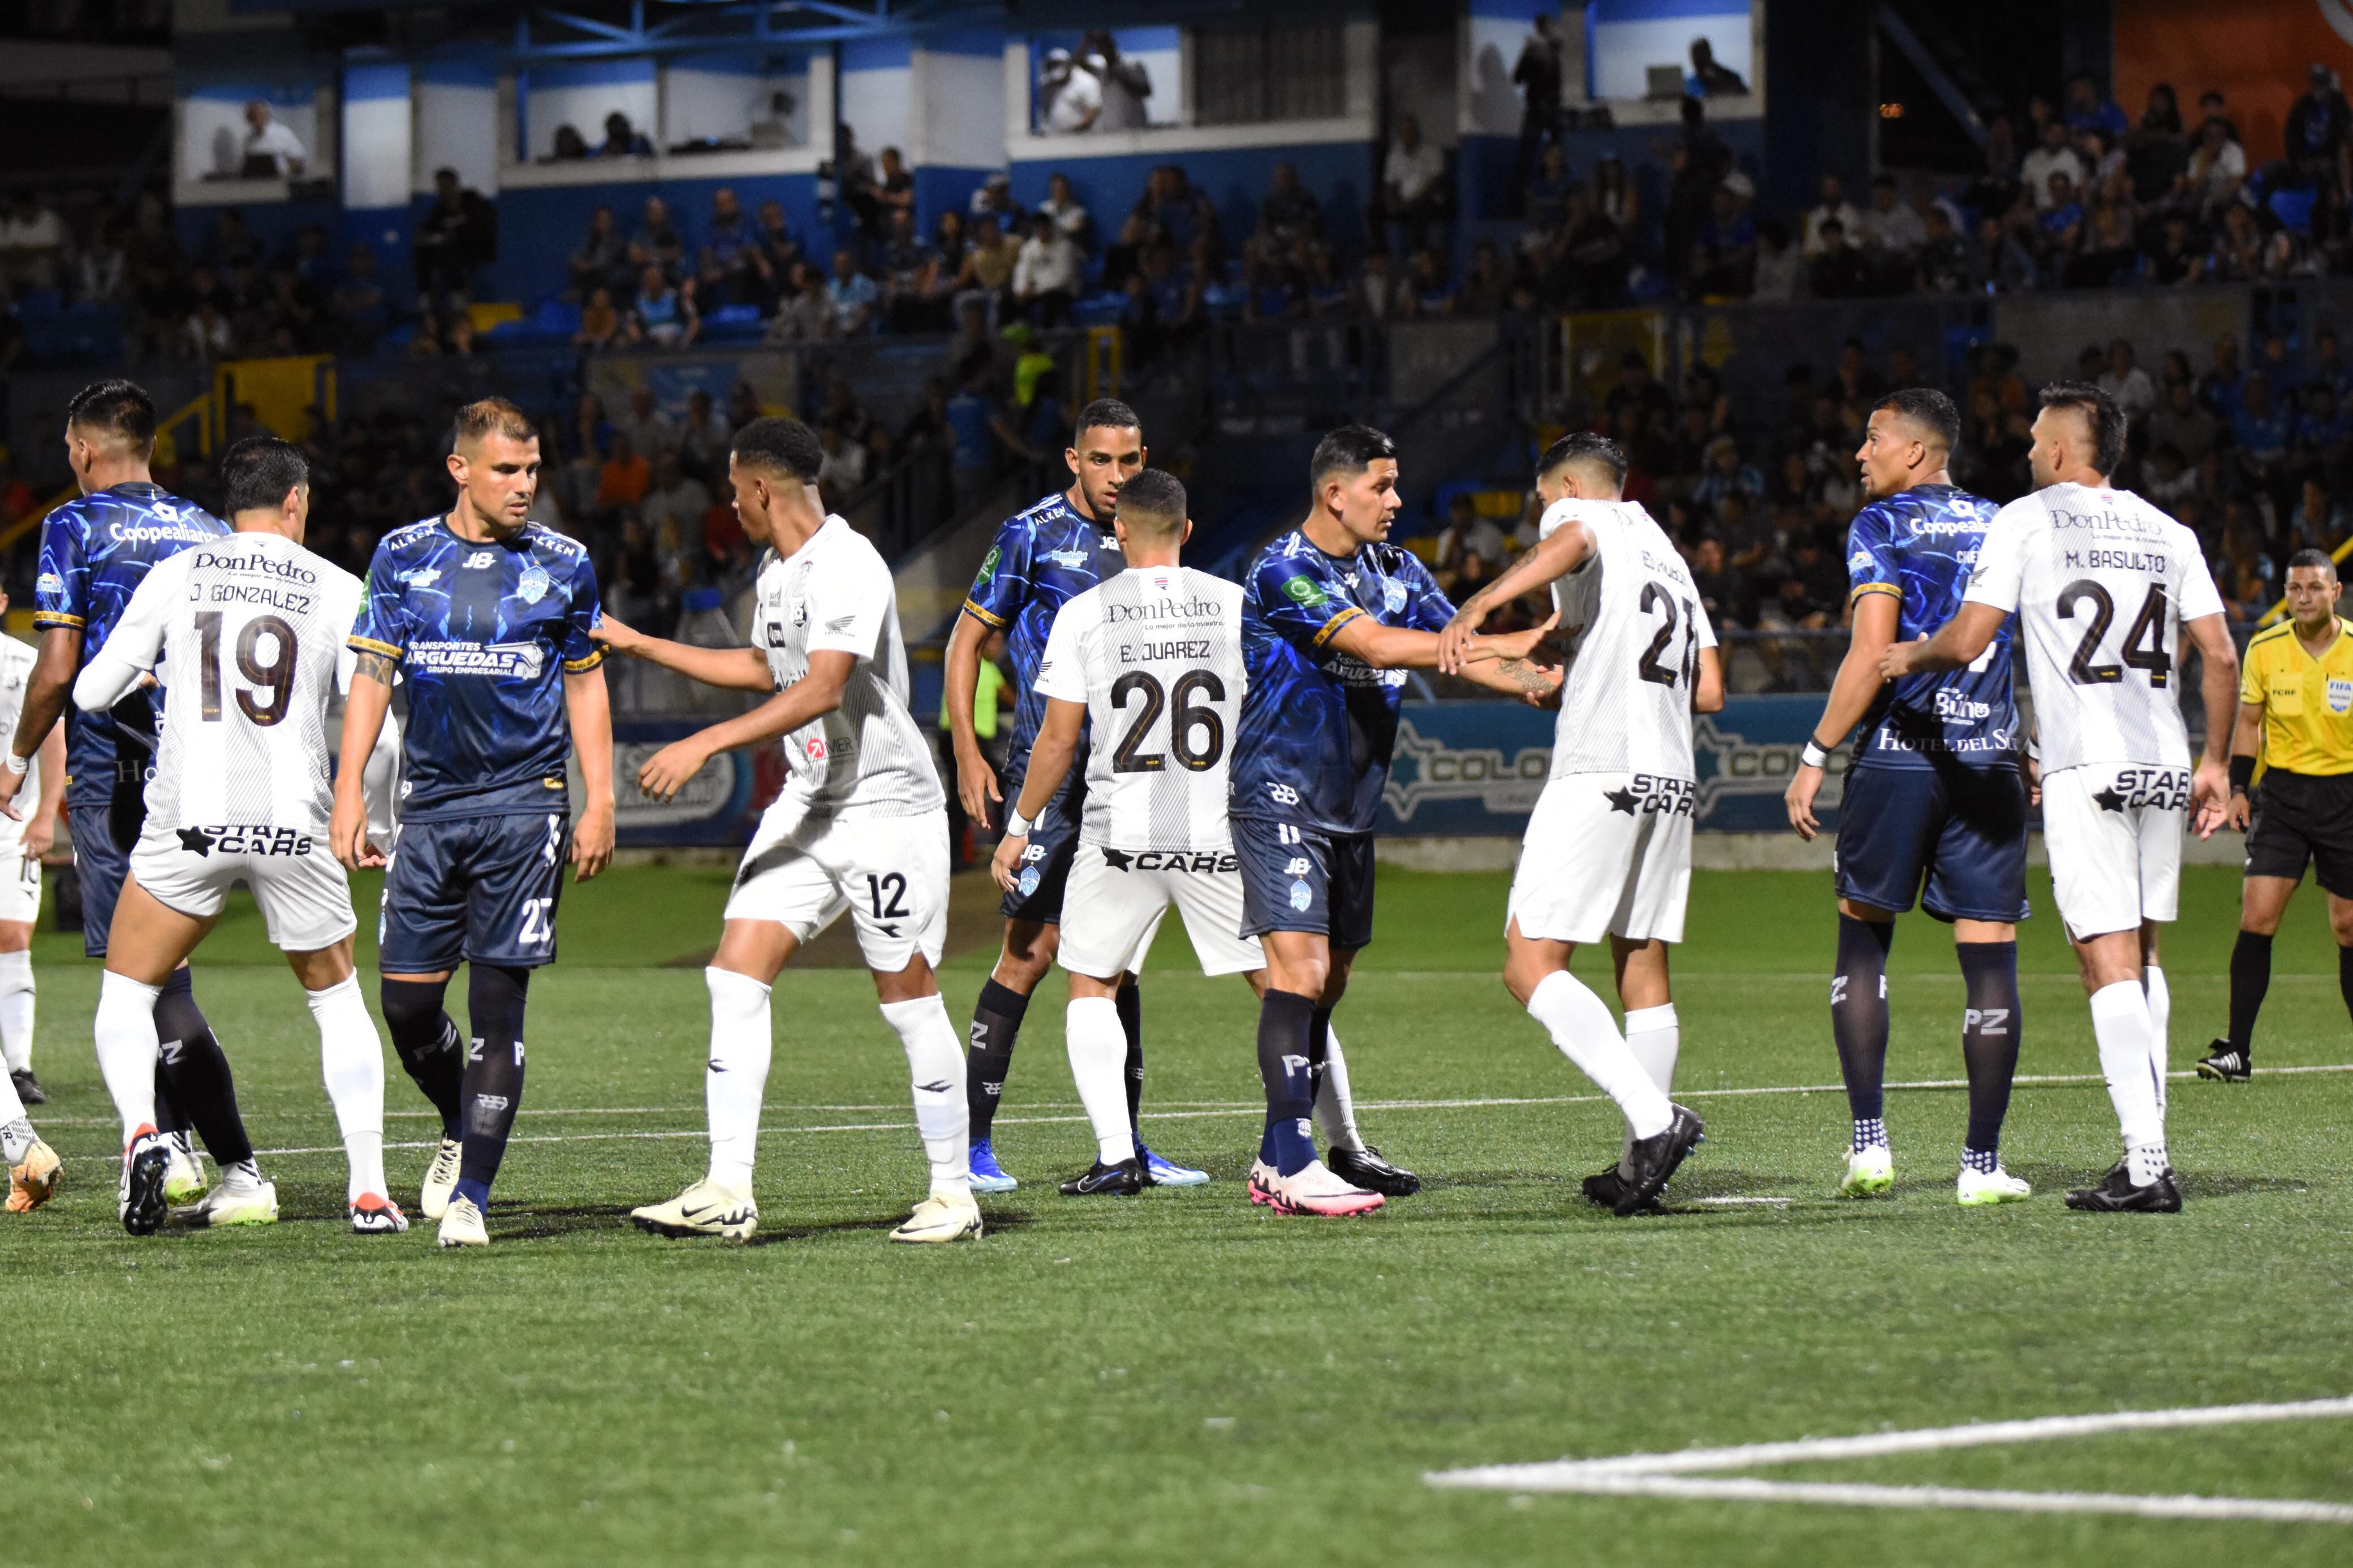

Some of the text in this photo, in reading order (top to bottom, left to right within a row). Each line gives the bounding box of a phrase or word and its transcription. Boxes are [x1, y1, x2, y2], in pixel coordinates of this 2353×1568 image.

[1035, 506, 1066, 526] ALKEN
[391, 526, 436, 551] ALKEN
[463, 552, 494, 568] JB
[2065, 550, 2165, 573] M. BASULTO
[211, 584, 310, 615] GONZALEZ
[2057, 579, 2171, 689] 24
[408, 641, 481, 651] TRANSPORTES
[1121, 640, 1210, 663] E. JUAREZ
[194, 610, 299, 727] 19
[406, 651, 516, 668] ARGUEDAS
[455, 666, 512, 676] EMPRESARIAL
[2330, 681, 2352, 692] FIFA
[1110, 669, 1226, 774] 26
[2116, 770, 2188, 792] STAR
[1643, 794, 1694, 818] CAR
[218, 836, 312, 856] CARS
[1022, 844, 1045, 861] JB
[1136, 853, 1239, 873] CARS
[1284, 857, 1309, 874] JB
[867, 871, 910, 919] 12
[519, 897, 553, 943] 27
[1963, 1009, 2009, 1035] PZ
